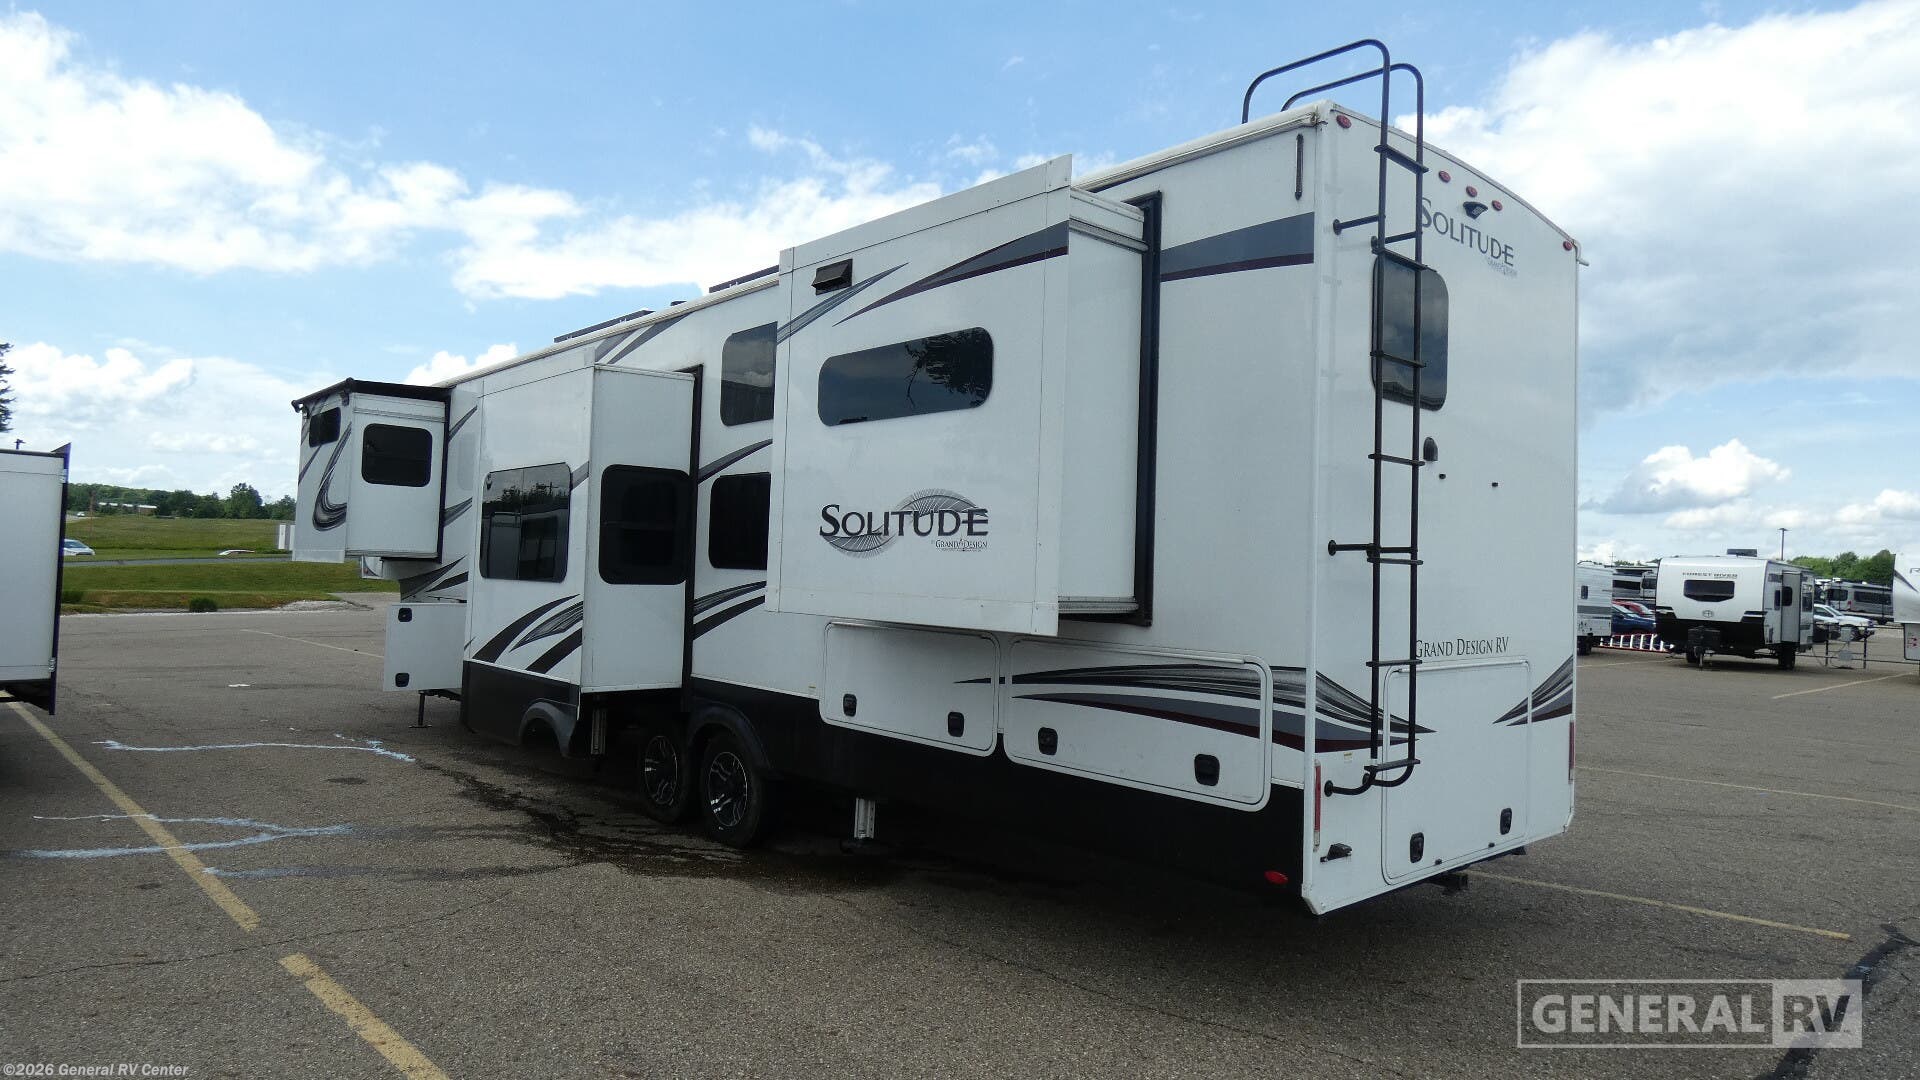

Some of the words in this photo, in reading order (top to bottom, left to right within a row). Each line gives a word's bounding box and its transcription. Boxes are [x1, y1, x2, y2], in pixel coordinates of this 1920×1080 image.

[1420, 196, 1514, 268] SOLITUDE
[819, 504, 989, 538] SOLITUDE
[935, 539, 960, 549] GRAND
[963, 539, 988, 549] DESIGN
[1415, 639, 1454, 658] GRAND
[1456, 638, 1494, 656] DESIGN
[1495, 636, 1510, 653] RV
